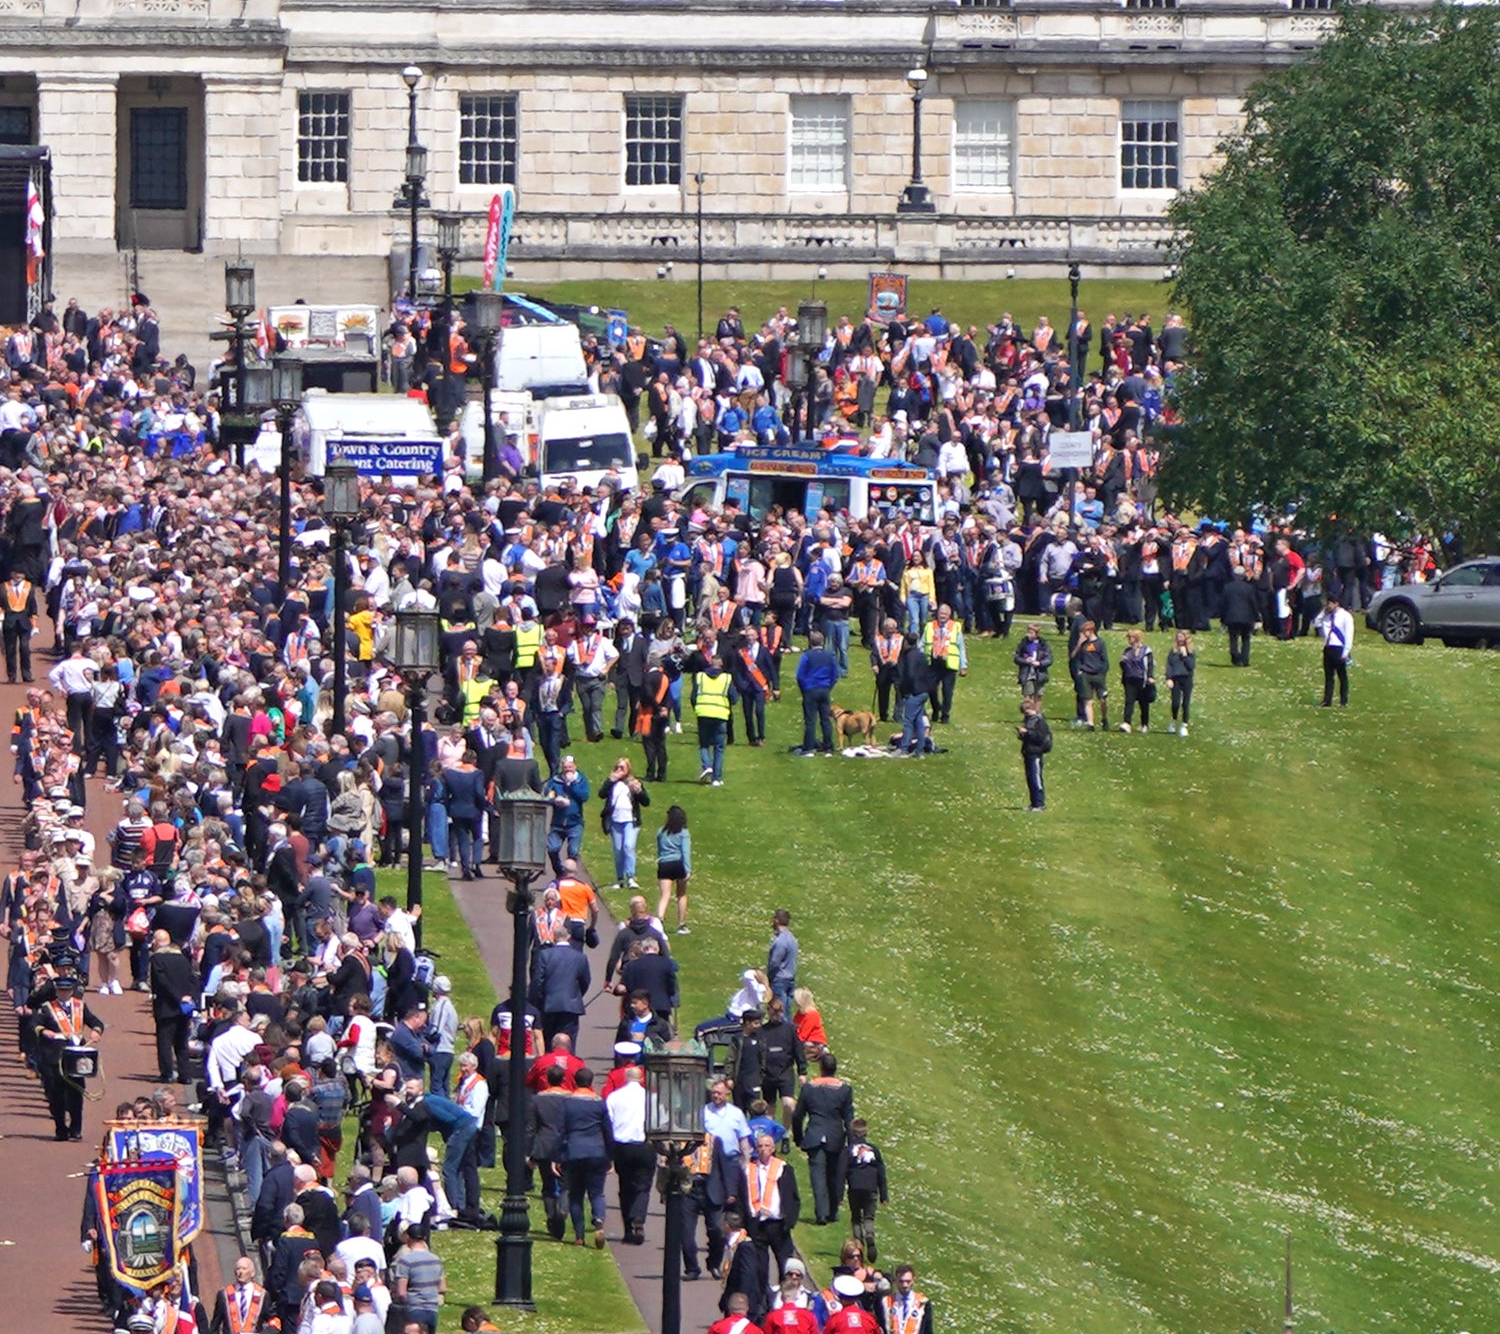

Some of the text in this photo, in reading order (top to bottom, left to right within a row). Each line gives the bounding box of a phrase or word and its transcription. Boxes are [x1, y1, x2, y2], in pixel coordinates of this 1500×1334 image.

[330, 443, 440, 459] Town & Country
[376, 457, 434, 473] Catering
